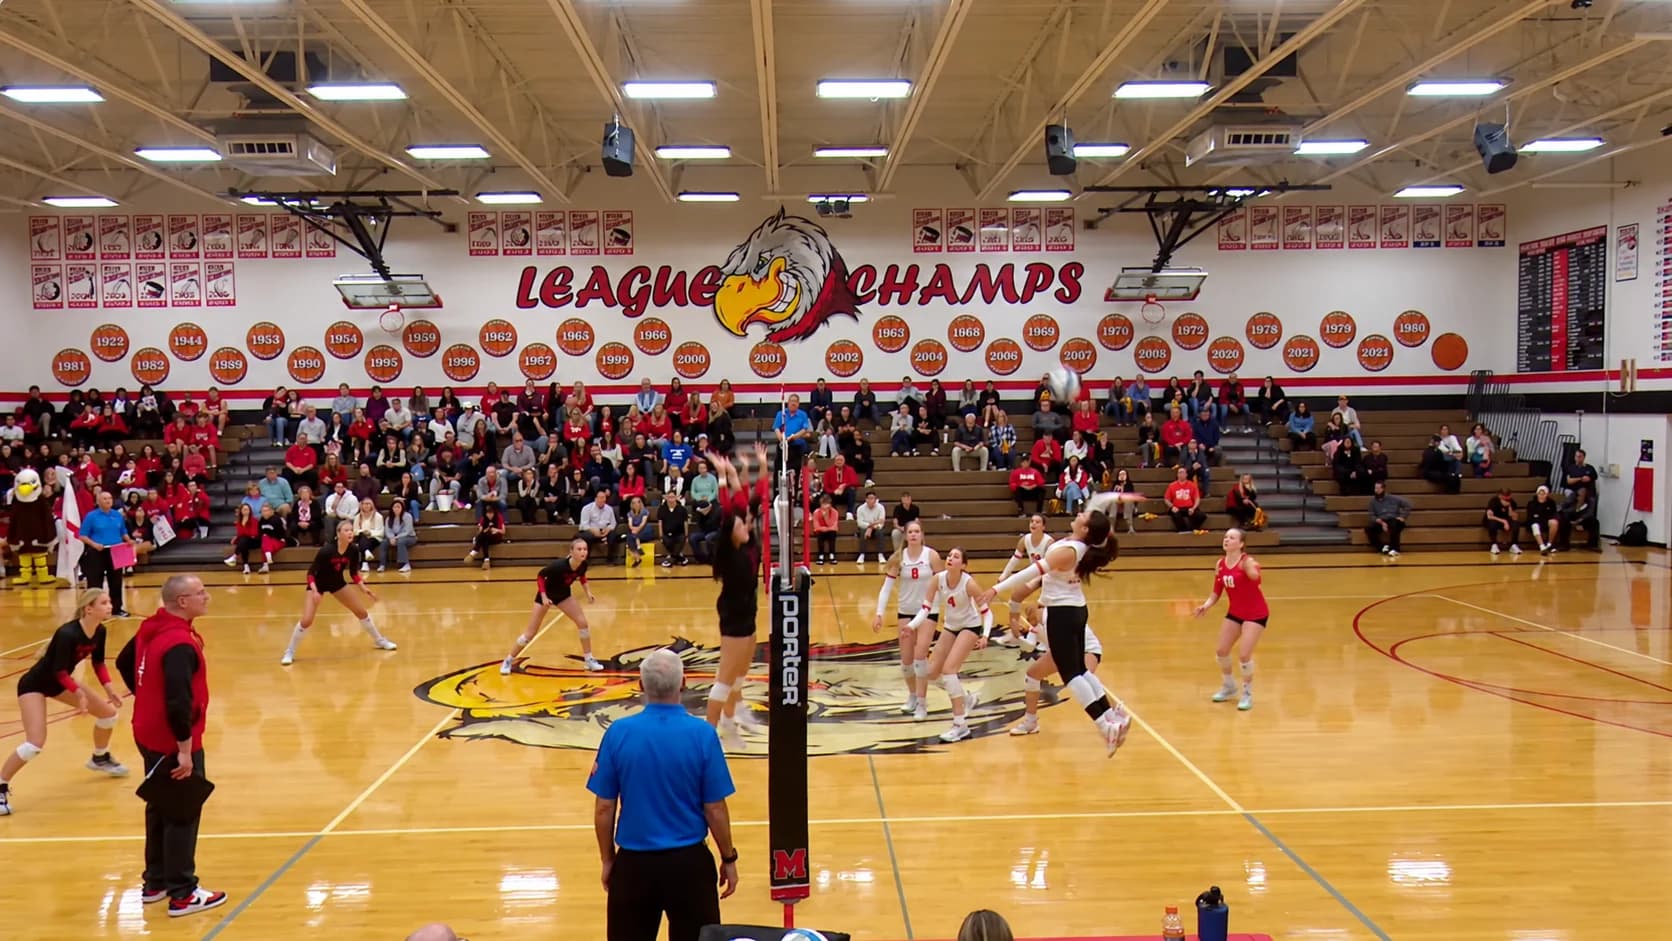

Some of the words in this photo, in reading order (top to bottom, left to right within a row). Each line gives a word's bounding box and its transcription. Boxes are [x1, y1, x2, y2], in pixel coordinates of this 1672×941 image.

[516, 265, 722, 318] LEAGUE
[848, 261, 1084, 305] CHAMPS
[639, 329, 667, 341] 1966
[1028, 326, 1055, 337] 1969
[1103, 326, 1129, 336] 1970
[97, 336, 125, 347] 1922
[174, 335, 203, 346] 1944
[753, 352, 781, 364] 2001
[1063, 350, 1092, 361] 2007
[1211, 349, 1240, 359] 2020
[1287, 347, 1314, 358] 2021
[1361, 347, 1388, 358] 2021
[293, 358, 321, 369] 1990
[370, 357, 398, 368] 1995
[448, 356, 476, 367] 1996
[601, 354, 630, 365] 1999
[677, 354, 706, 364] 2000
[58, 361, 85, 372] 1981
[911, 567, 919, 579] 8
[948, 597, 956, 607] 4
[774, 849, 806, 878] M
